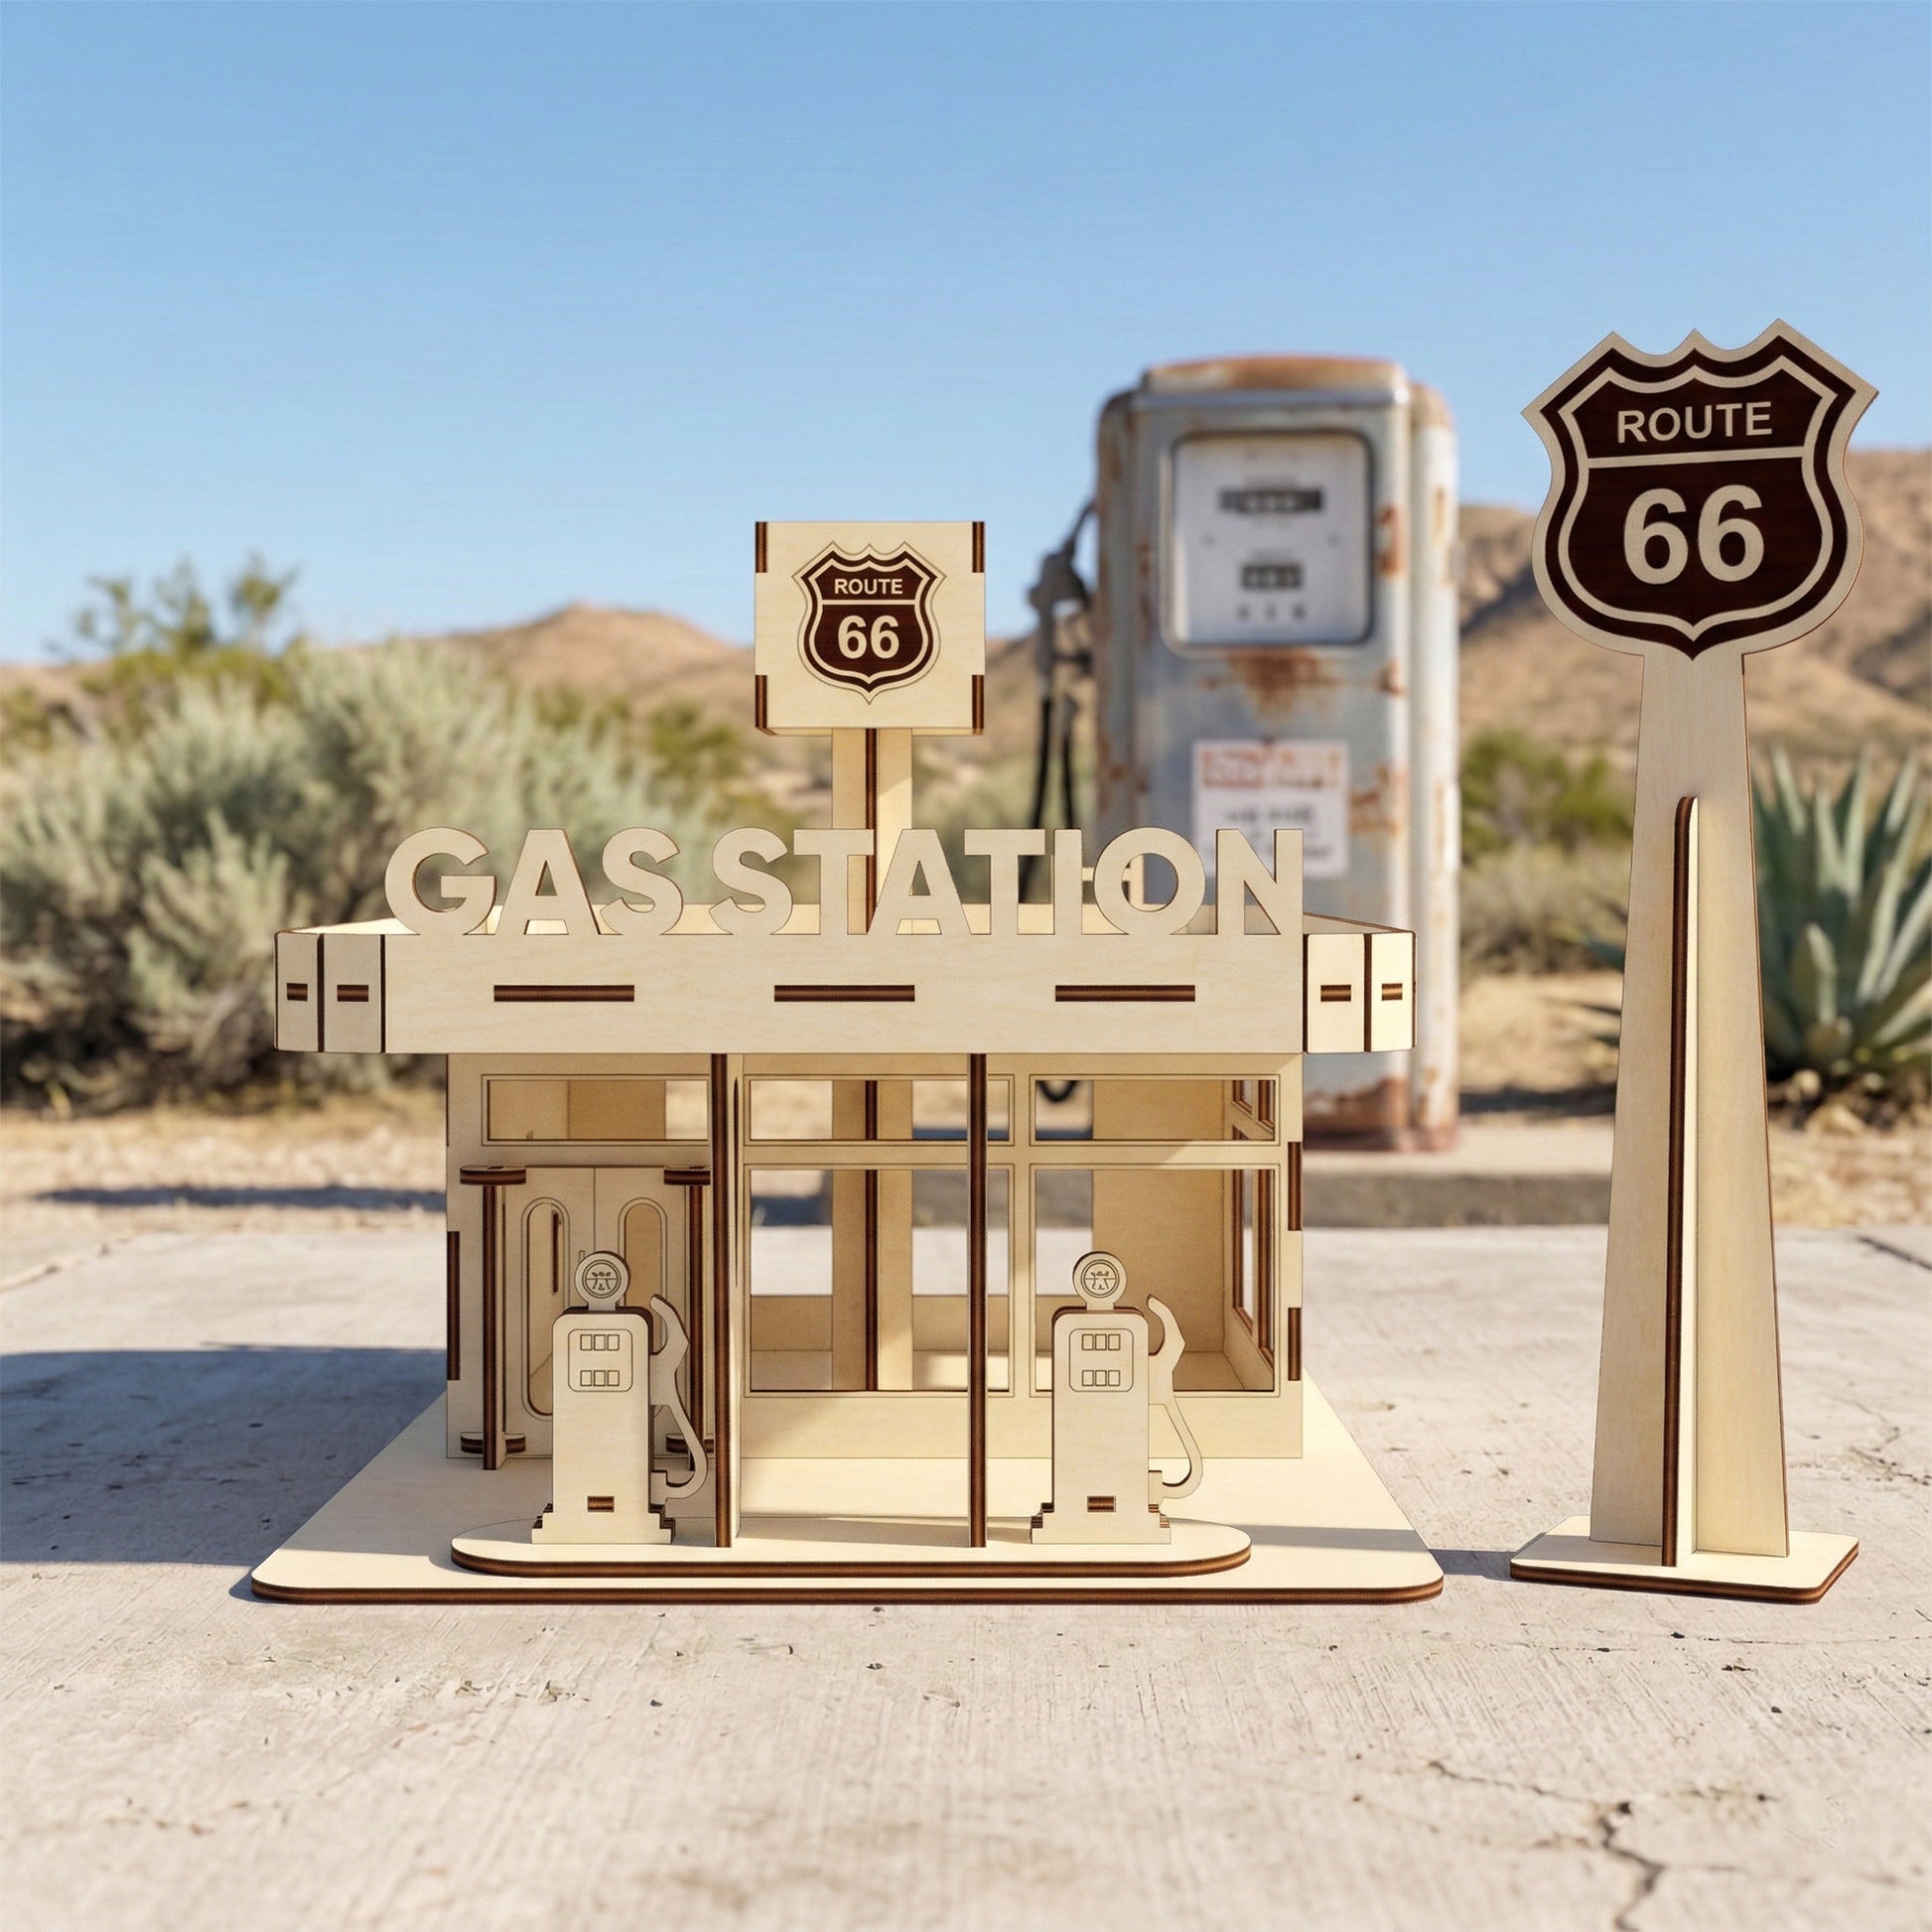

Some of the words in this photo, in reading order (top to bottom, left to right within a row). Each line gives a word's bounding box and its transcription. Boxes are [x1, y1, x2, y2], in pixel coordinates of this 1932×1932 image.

[1617, 401, 1773, 444] ROUTE
[1623, 483, 1765, 586] 66
[833, 578, 904, 596] ROUTE
[837, 615, 900, 659] 66
[384, 826, 684, 936] GAS
[708, 826, 1304, 936] STATION
